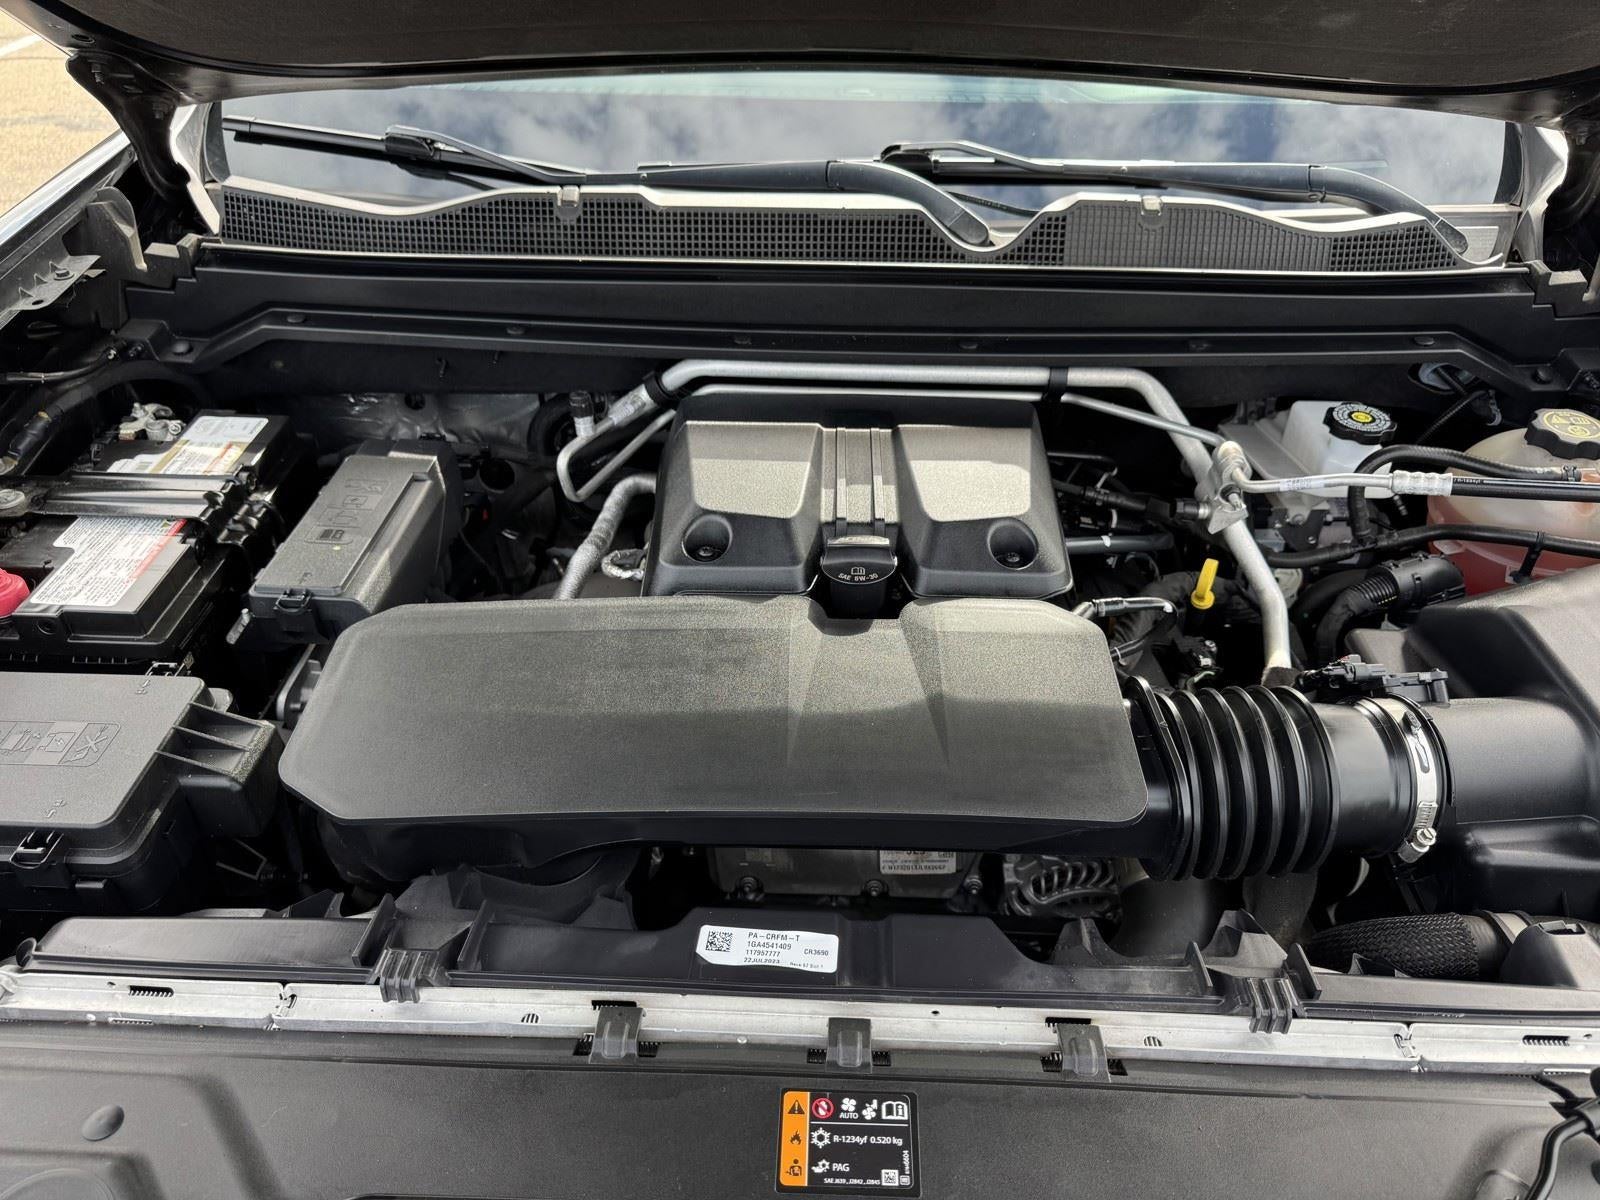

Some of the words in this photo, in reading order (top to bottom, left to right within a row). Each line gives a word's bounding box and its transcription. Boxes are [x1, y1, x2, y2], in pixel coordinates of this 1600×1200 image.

[838, 573, 852, 581] SAE
[854, 573, 878, 581] 5W-30
[747, 940, 792, 950] 1GA4541409
[745, 949, 781, 957] 117957777
[839, 1112, 859, 1120] AUTO
[833, 1135, 867, 1145] R-1234yf
[870, 1136, 892, 1144] 0.520
[893, 1136, 903, 1146] kg
[832, 1163, 850, 1172] PAG
